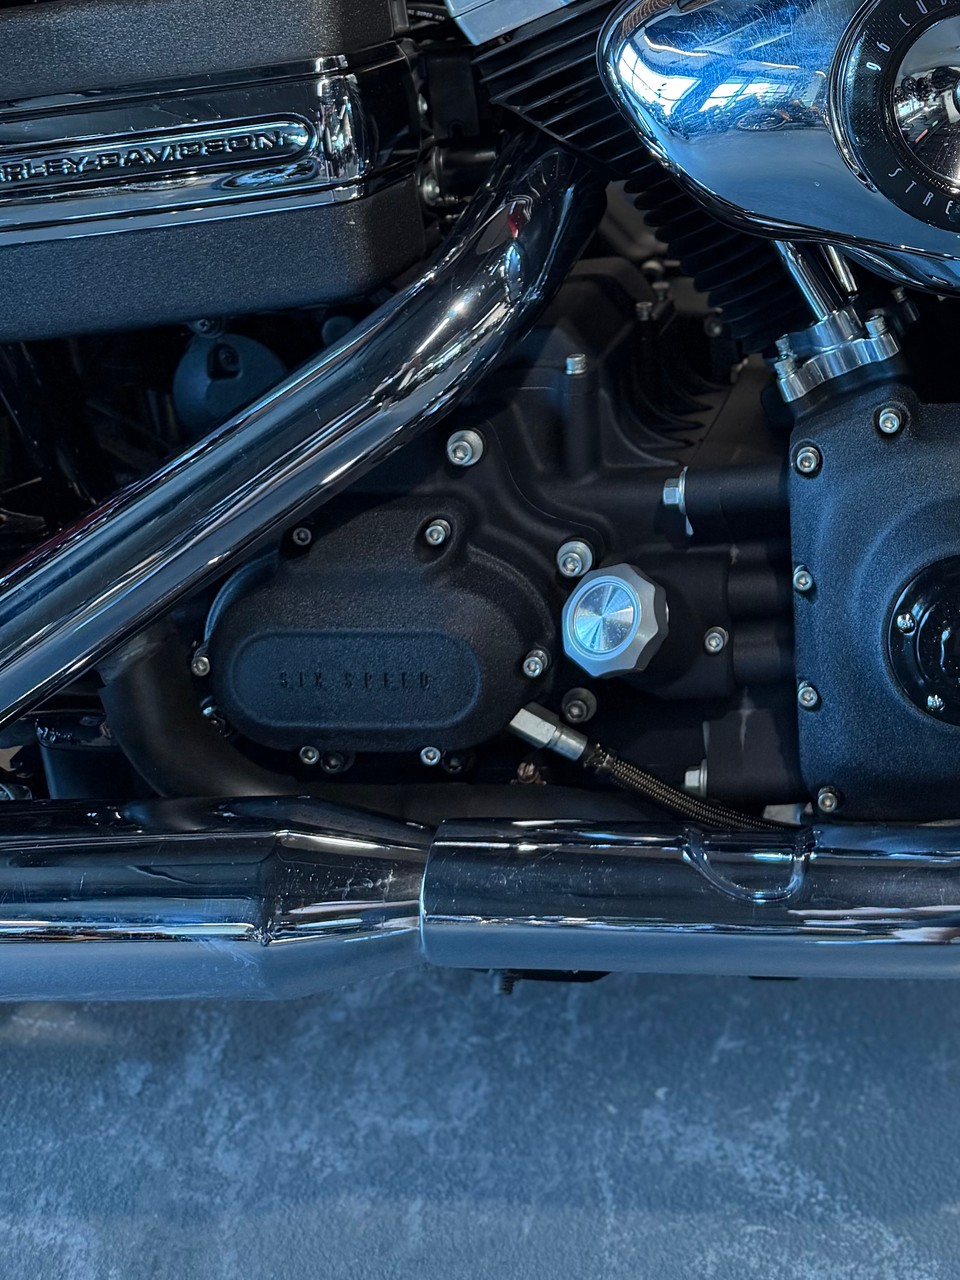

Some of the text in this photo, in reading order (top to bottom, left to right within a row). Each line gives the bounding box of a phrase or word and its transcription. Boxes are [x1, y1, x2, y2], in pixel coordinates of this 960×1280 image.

[866, 40, 891, 72] 96
[0, 130, 286, 182] RLEY-DAVIDSON
[279, 671, 323, 689] SIX
